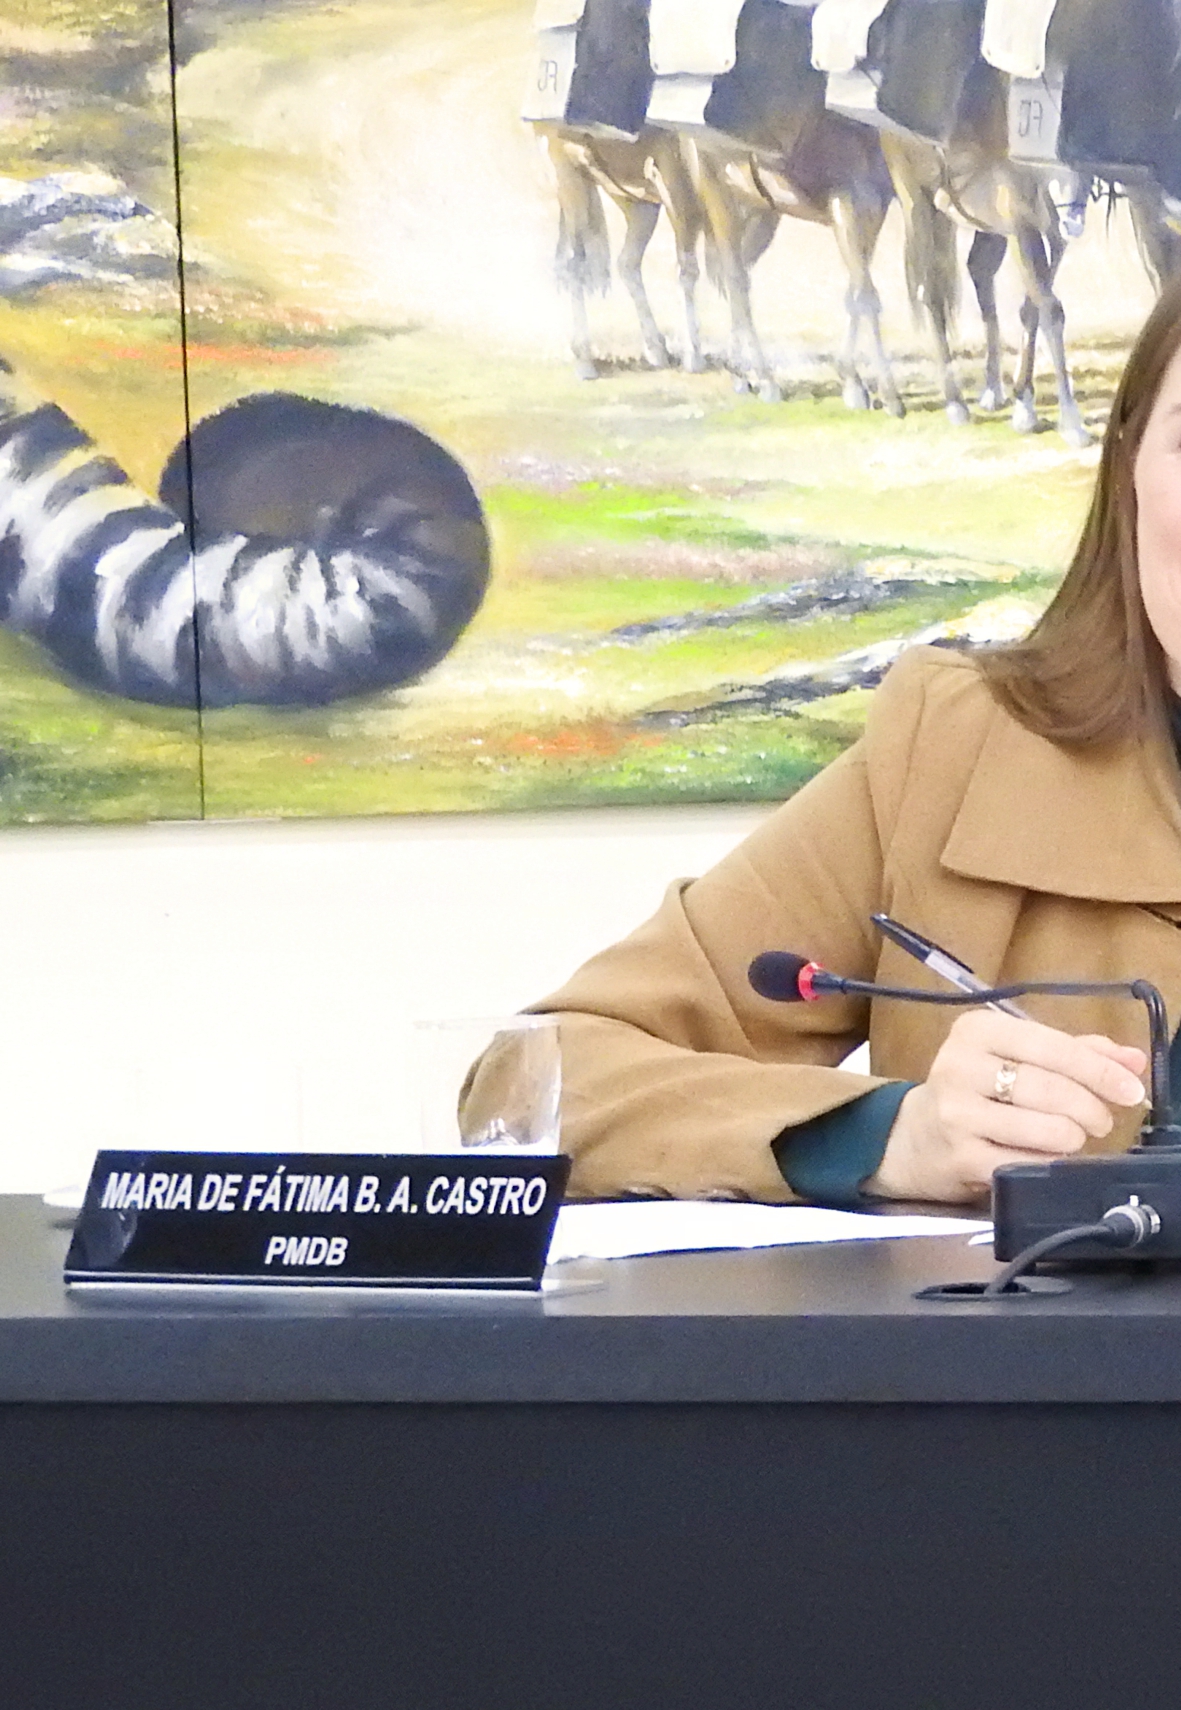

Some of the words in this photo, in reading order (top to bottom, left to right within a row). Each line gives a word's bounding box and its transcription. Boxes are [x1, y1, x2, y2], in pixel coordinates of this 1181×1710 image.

[101, 1172, 192, 1210] MARIA
[199, 1174, 239, 1211] DE
[247, 1165, 348, 1213] FÁTIMA
[354, 1175, 381, 1213] B.
[387, 1176, 418, 1214] A.
[425, 1176, 547, 1216] CASTRO
[264, 1236, 349, 1266] PMDB
